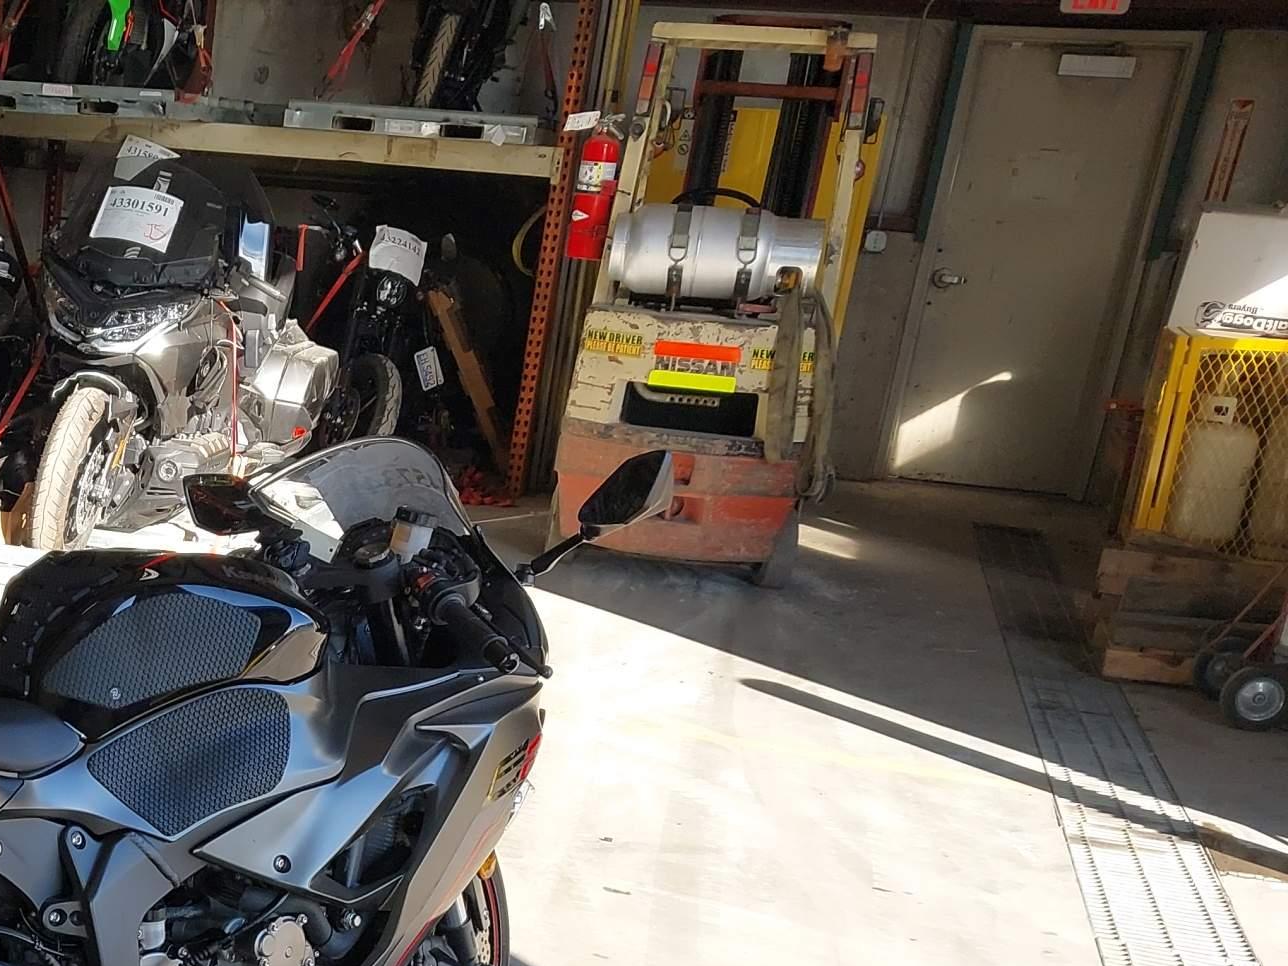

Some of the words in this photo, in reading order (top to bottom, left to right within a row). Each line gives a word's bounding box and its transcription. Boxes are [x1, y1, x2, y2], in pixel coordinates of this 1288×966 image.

[111, 197, 169, 217] 43301591
[588, 330, 608, 340] NEW
[608, 332, 643, 345] DRIVER
[752, 348, 776, 359] NEW
[655, 355, 736, 377] NISSAN
